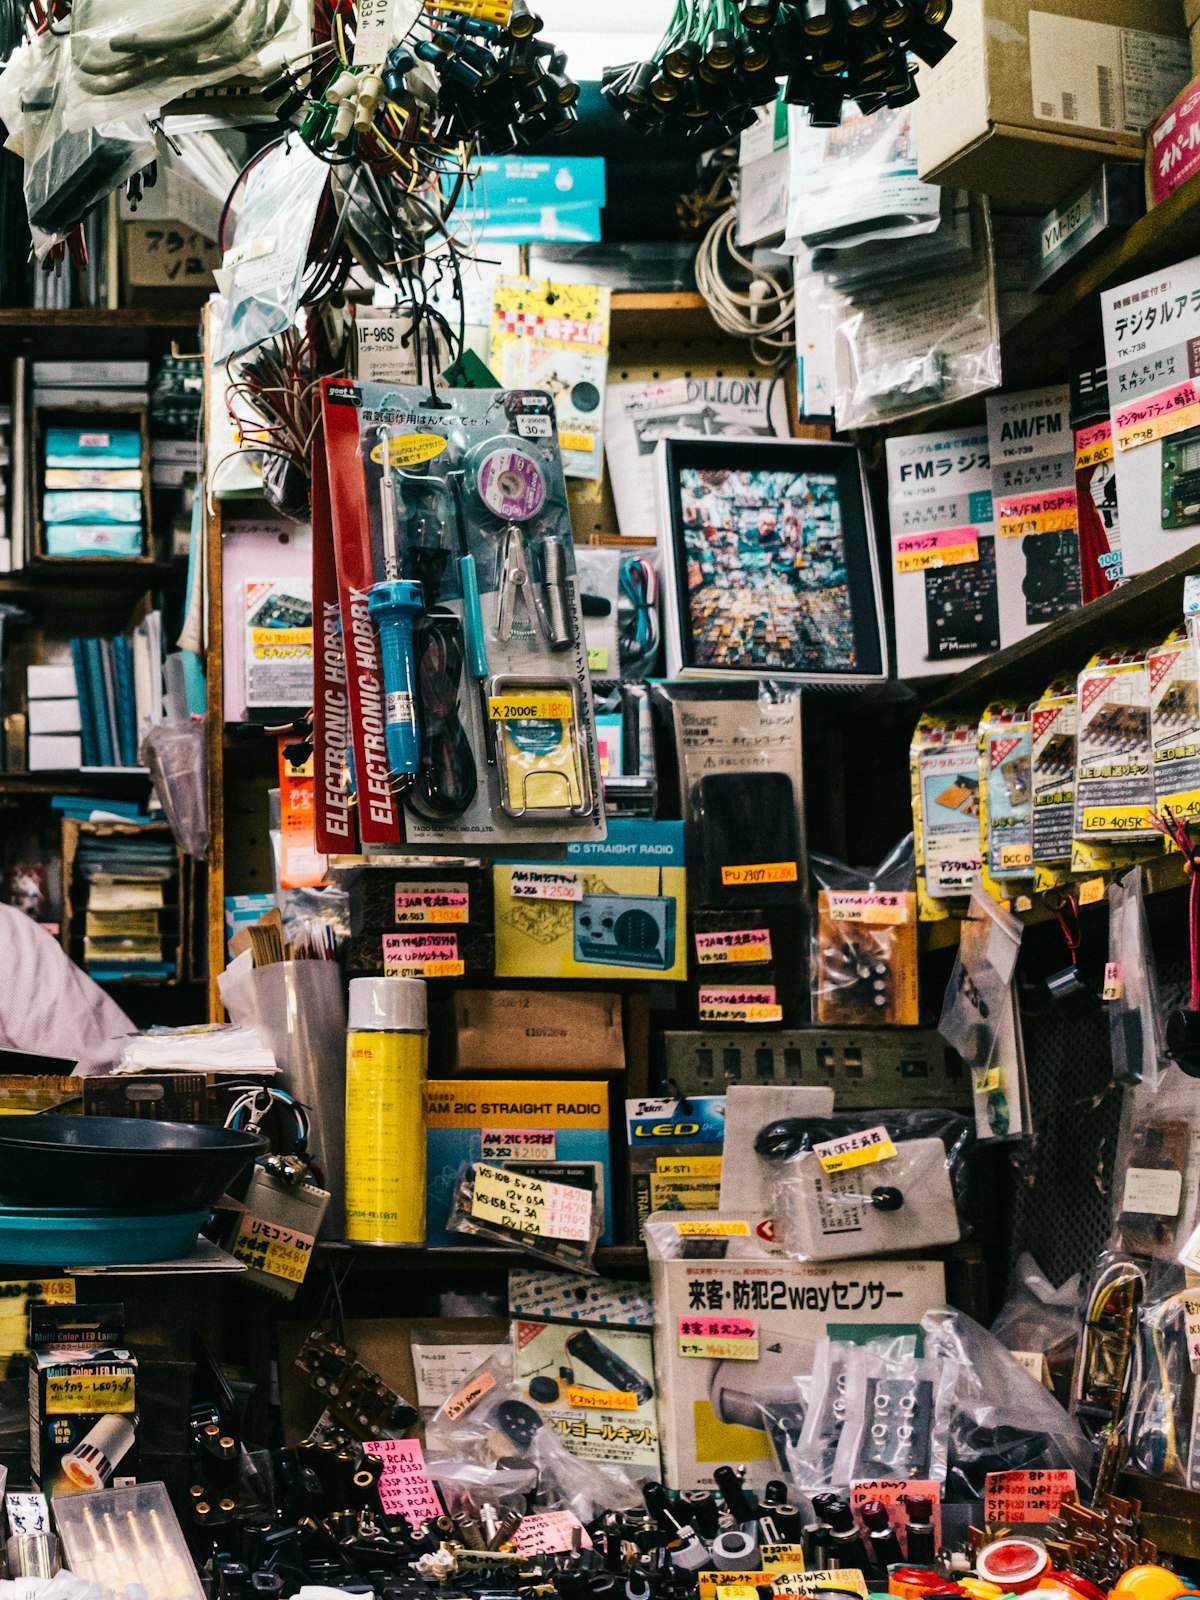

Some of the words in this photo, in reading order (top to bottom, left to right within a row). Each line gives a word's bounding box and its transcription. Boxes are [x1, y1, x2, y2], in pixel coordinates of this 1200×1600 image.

[359, 326, 395, 343] IF-96S
[1118, 342, 1147, 358] TK-738
[1001, 413, 1062, 442] AM/FM
[349, 586, 380, 671] HOBBY
[358, 673, 394, 826] ELECTRONIC
[324, 687, 349, 838] ELECTRONIC
[583, 843, 637, 856] STRAIGHT
[639, 844, 674, 856] RADIO
[428, 1103, 450, 1114] AM
[454, 1103, 477, 1114] 2IC
[481, 1103, 552, 1114] STRAIGHT
[557, 1103, 601, 1115] RADIO
[634, 1122, 700, 1137] LED
[250, 1221, 294, 1244] リモコン
[46, 1366, 70, 1377] Multi
[70, 1367, 94, 1377] Color
[95, 1366, 111, 1377] LED
[1028, 1471, 1044, 1481] 8P
[988, 1485, 1004, 1496] 4P
[1027, 1485, 1046, 1496] 10P
[988, 1499, 1005, 1510] 5P
[1026, 1499, 1046, 1510] 12P
[989, 1511, 1005, 1522] 6P
